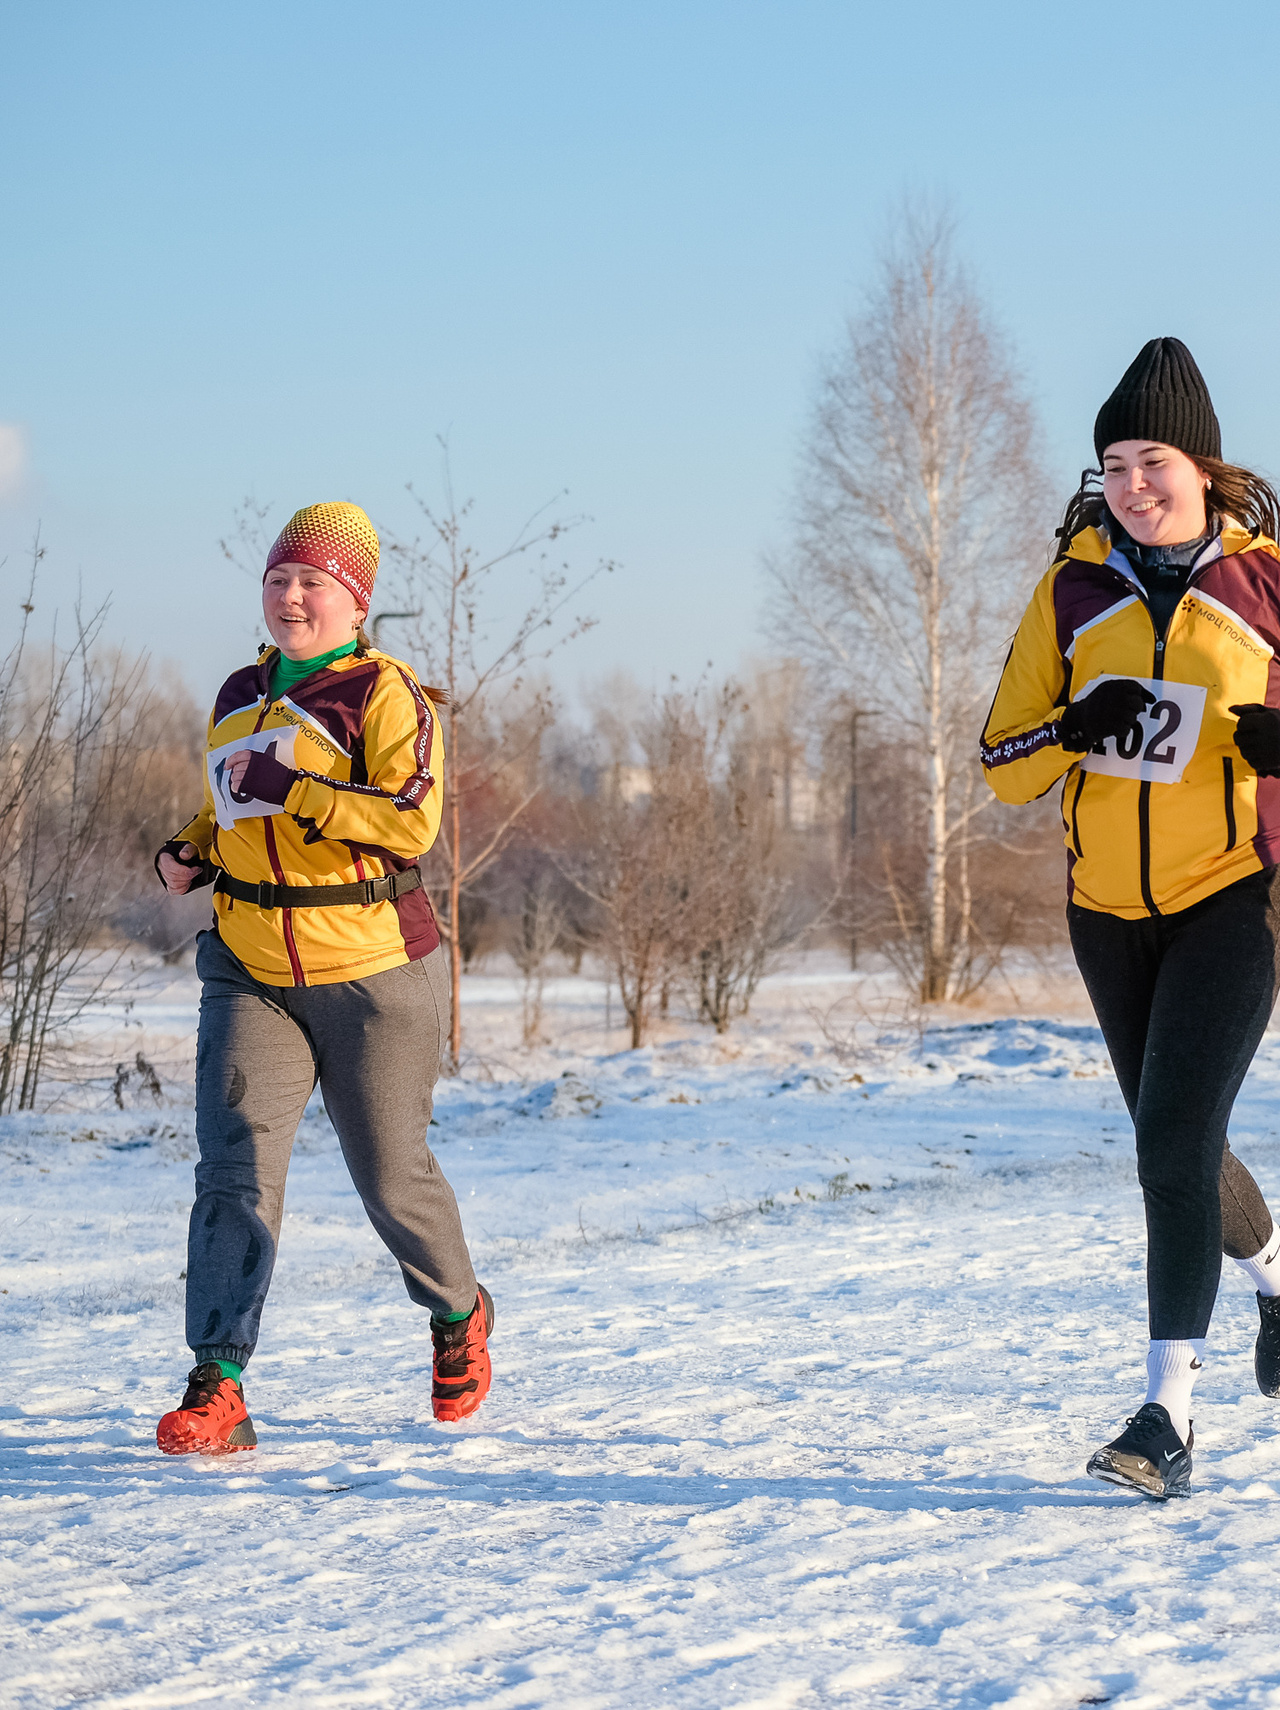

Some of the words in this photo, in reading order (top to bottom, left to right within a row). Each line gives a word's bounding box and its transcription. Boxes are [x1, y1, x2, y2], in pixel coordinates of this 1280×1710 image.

[341, 571, 364, 595] МФЦ
[1197, 608, 1223, 629] МФЦ
[1224, 625, 1262, 656] ПОЛЮС
[282, 712, 299, 726] МФЦ
[299, 724, 337, 758] ПОЛЮС
[418, 731, 429, 763] ПОЛЮ
[405, 780, 423, 800] МФЦ
